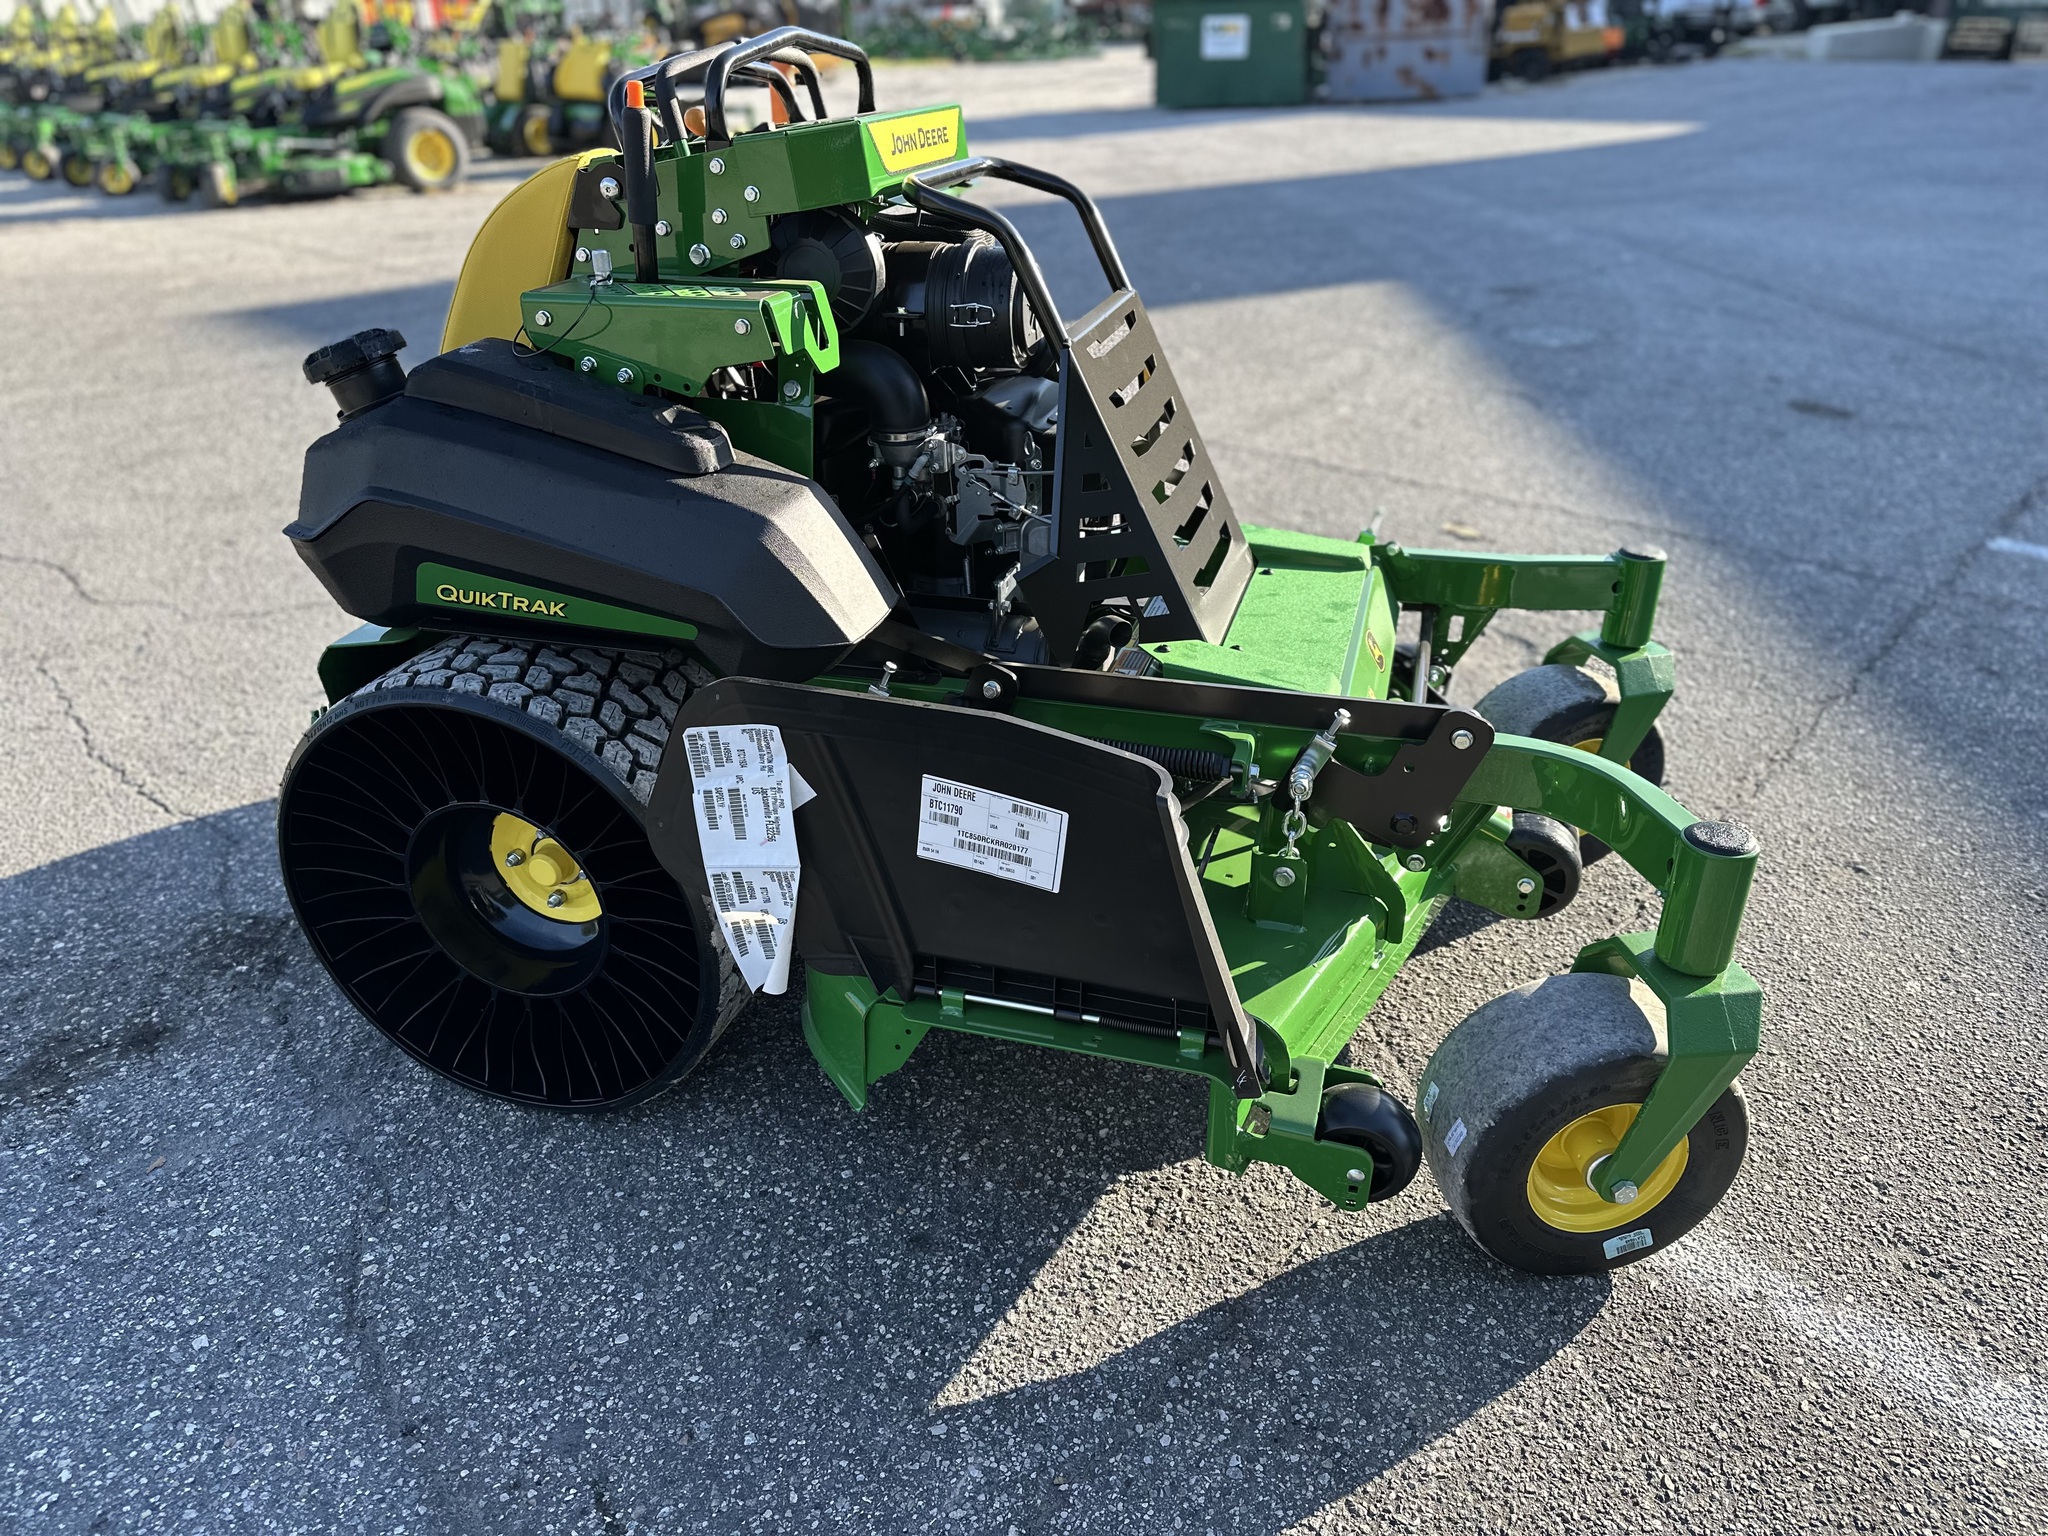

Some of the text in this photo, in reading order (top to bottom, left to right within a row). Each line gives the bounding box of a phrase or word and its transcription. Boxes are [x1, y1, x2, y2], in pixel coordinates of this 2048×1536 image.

[891, 126, 949, 156] JOHN DEERE
[354, 698, 370, 710] NOT
[372, 694, 388, 705] FOR
[508, 710, 553, 741] TWEEL
[559, 737, 593, 765] TURF
[760, 787, 773, 819] Jacksonville
[932, 782, 952, 796] JOHN
[953, 787, 976, 802] DEERE
[929, 798, 963, 816] BTC11790
